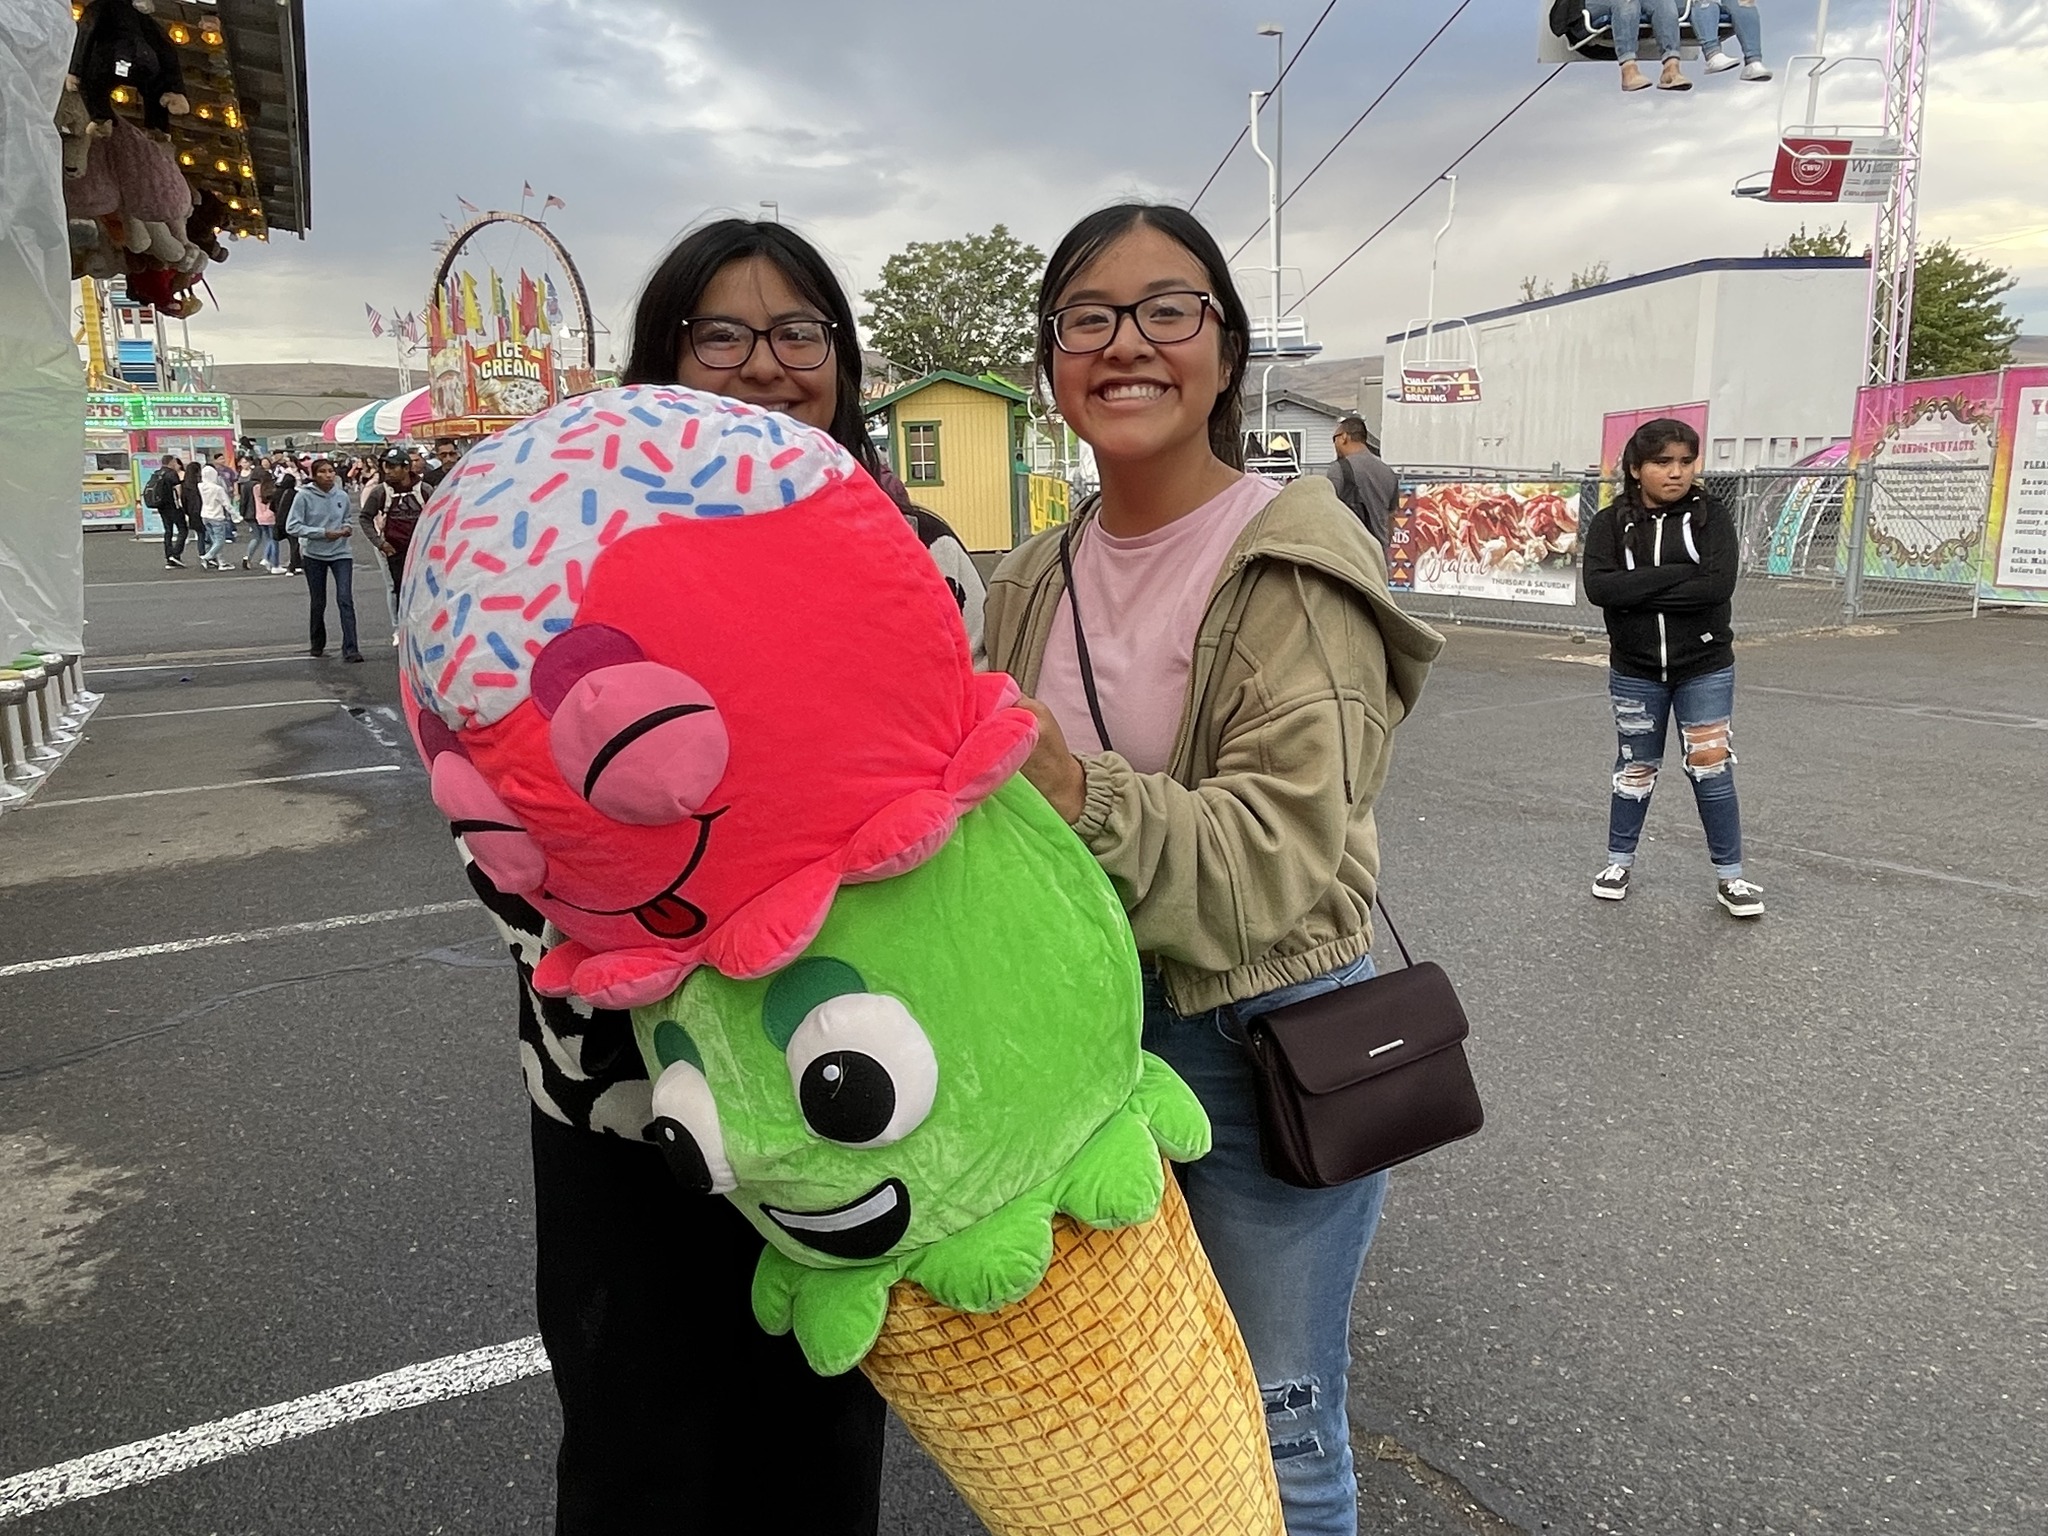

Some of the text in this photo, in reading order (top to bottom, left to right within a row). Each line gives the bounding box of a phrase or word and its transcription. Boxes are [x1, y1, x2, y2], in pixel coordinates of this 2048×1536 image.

[497, 341, 523, 358] ICE
[481, 359, 540, 380] CREAM
[1404, 385, 1432, 394] CRAFT
[1405, 394, 1447, 402] BREWING
[155, 406, 220, 418] TICKETS
[2023, 460, 2048, 469] PLEA
[2015, 528, 2047, 537] securing
[2012, 547, 2036, 555] Please
[2031, 557, 2048, 565] Mak
[2010, 566, 2034, 574] before
[1491, 577, 1525, 587] THURSDAY
[1534, 580, 1570, 590] SATURDAY
[1515, 588, 1545, 596] 4PM-9PM
